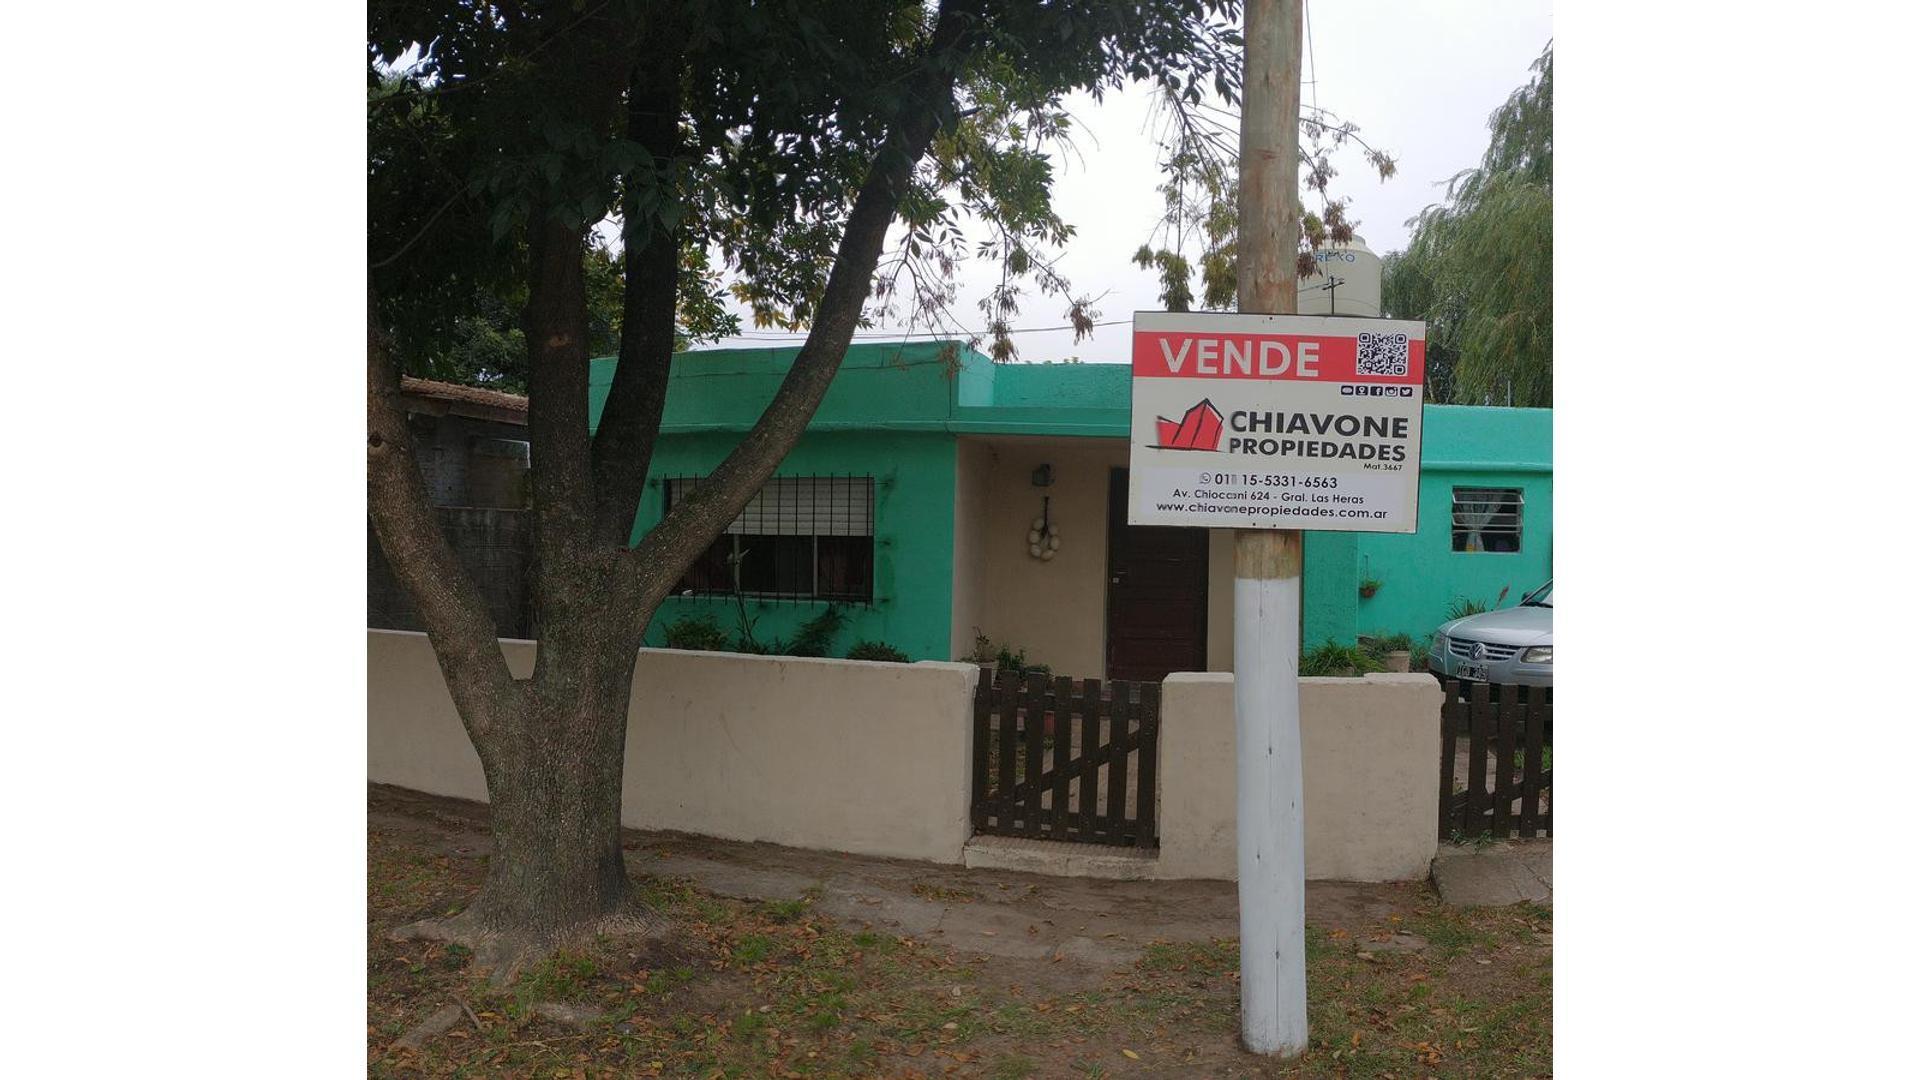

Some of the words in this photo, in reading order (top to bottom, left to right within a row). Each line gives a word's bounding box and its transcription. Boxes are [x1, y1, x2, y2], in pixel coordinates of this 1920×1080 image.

[1159, 337, 1321, 377] VENDE
[1230, 410, 1409, 439] CHIAVONE
[1229, 437, 1406, 462] PROPIEDADES
[1242, 474, 1338, 489] 15-5331-6563
[1173, 488, 1191, 499] Av.
[1250, 491, 1270, 501] 624
[1281, 492, 1308, 502] Gral.
[1311, 494, 1329, 503] Las
[1332, 494, 1364, 505] Heras
